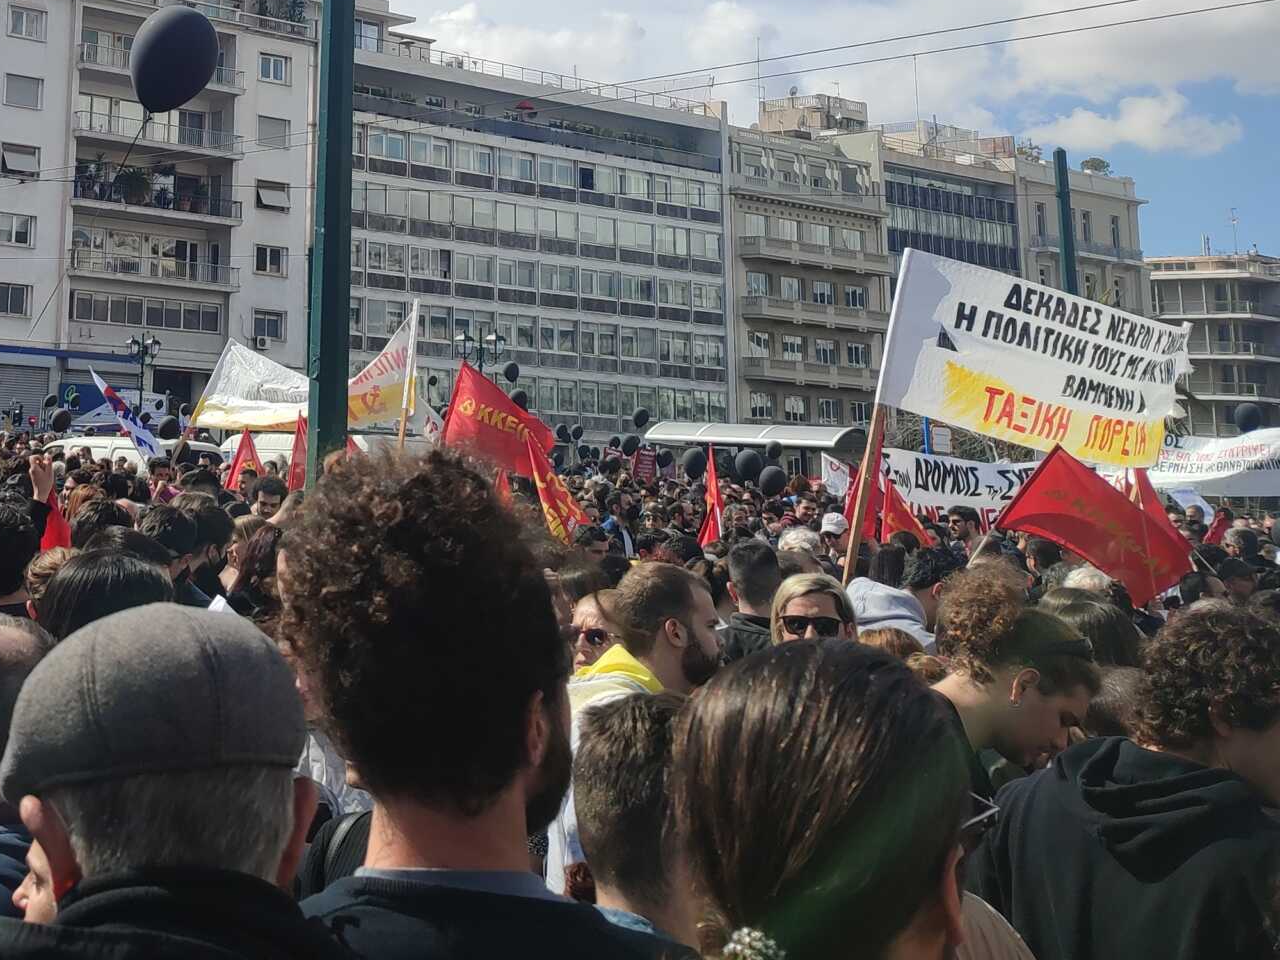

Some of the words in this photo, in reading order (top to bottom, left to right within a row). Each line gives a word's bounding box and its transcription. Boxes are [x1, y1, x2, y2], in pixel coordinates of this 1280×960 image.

[954, 301, 978, 332] Η
[981, 309, 1089, 366] ΠΟΛΙΤΙΚΗ
[1088, 343, 1126, 376] ΤΟΥΣ
[1004, 283, 1103, 336] ΔΕΚΑΔΕΣ
[1105, 313, 1155, 351] ΝΕΚΡΟΙ
[983, 386, 1072, 441] ΤΑΞΙΚΗ
[1084, 415, 1147, 456] ΠΟΡΕΙΑ
[1061, 374, 1135, 412] ΒΑΜΜΕΝΗ
[914, 457, 982, 497] ΔΡΟΜΟΥΣ
